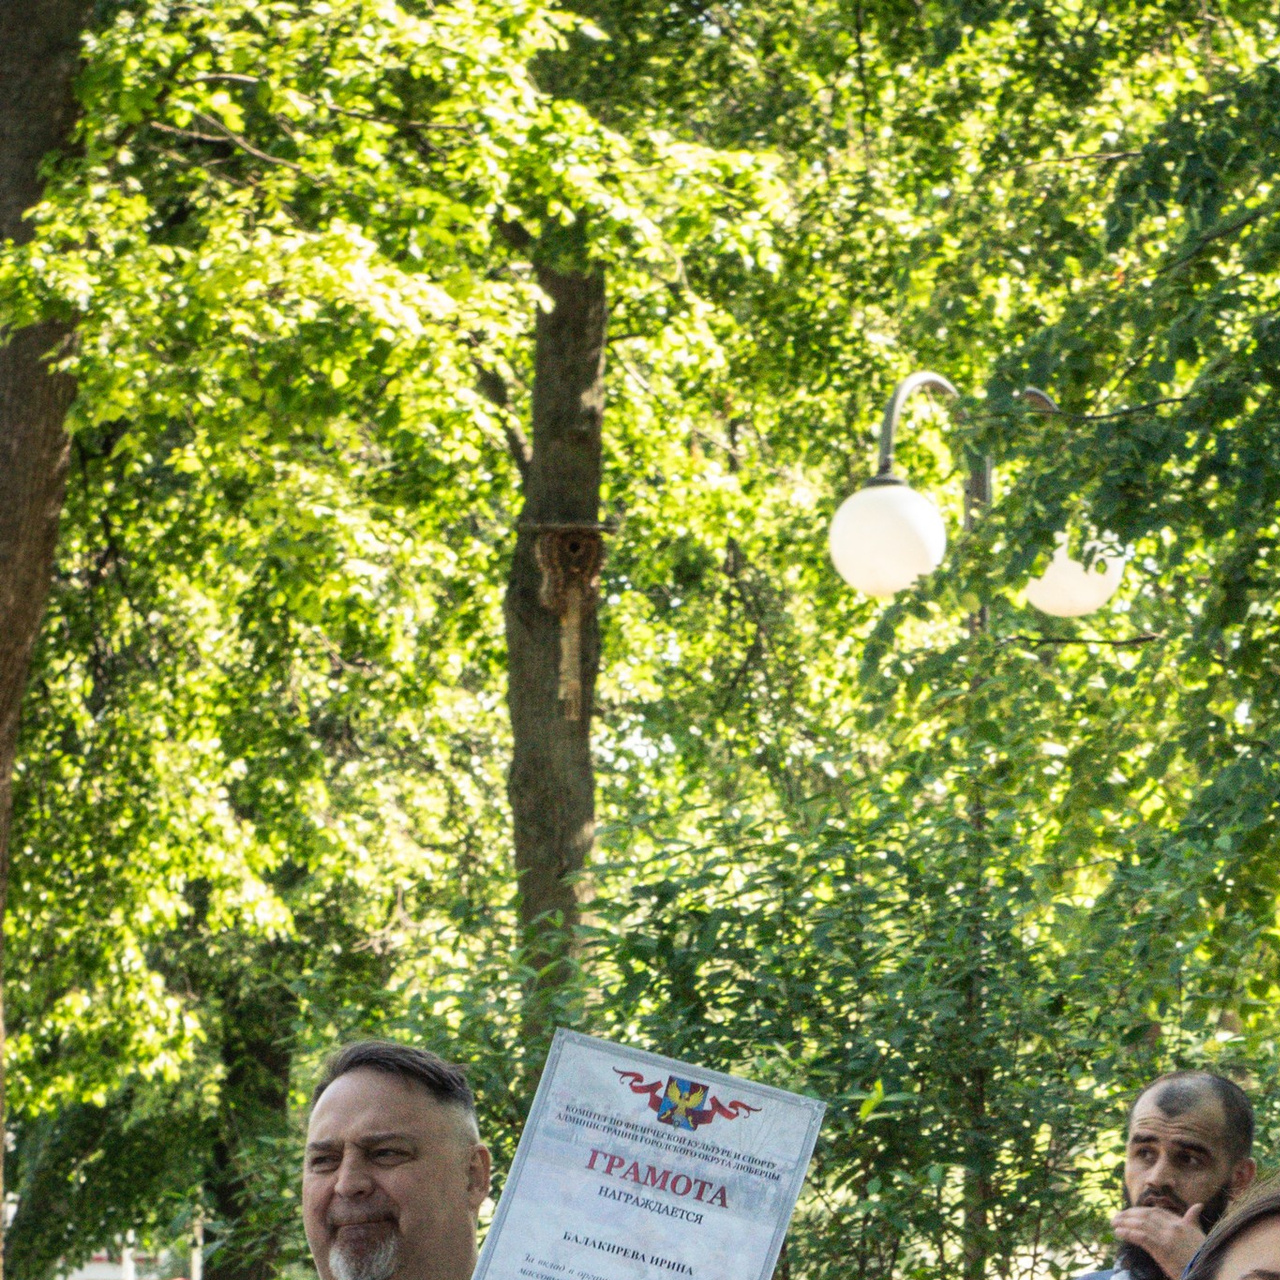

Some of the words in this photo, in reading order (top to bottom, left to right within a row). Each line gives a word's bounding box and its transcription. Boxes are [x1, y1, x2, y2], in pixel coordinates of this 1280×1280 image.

[554, 1111, 639, 1142] АДМИНИСТРАЦИИ
[638, 1134, 698, 1158] ГОРОДСКОГО
[697, 1151, 732, 1168] ОКРУГА
[731, 1161, 781, 1182] ЛЮБЕРЦЫ
[686, 1138, 733, 1158] КУЛЬТУРЕ
[733, 1151, 741, 1160] И
[741, 1153, 777, 1170] СПОРТУ
[584, 1148, 730, 1209] ГРАМОТА
[596, 1185, 704, 1225] НАГРАЖДАЕТСЯ
[523, 1253, 535, 1264] За
[536, 1258, 566, 1273] вклад
[562, 1230, 648, 1262] БАЛАКИРЕВА
[648, 1255, 695, 1276] ИРИНА
